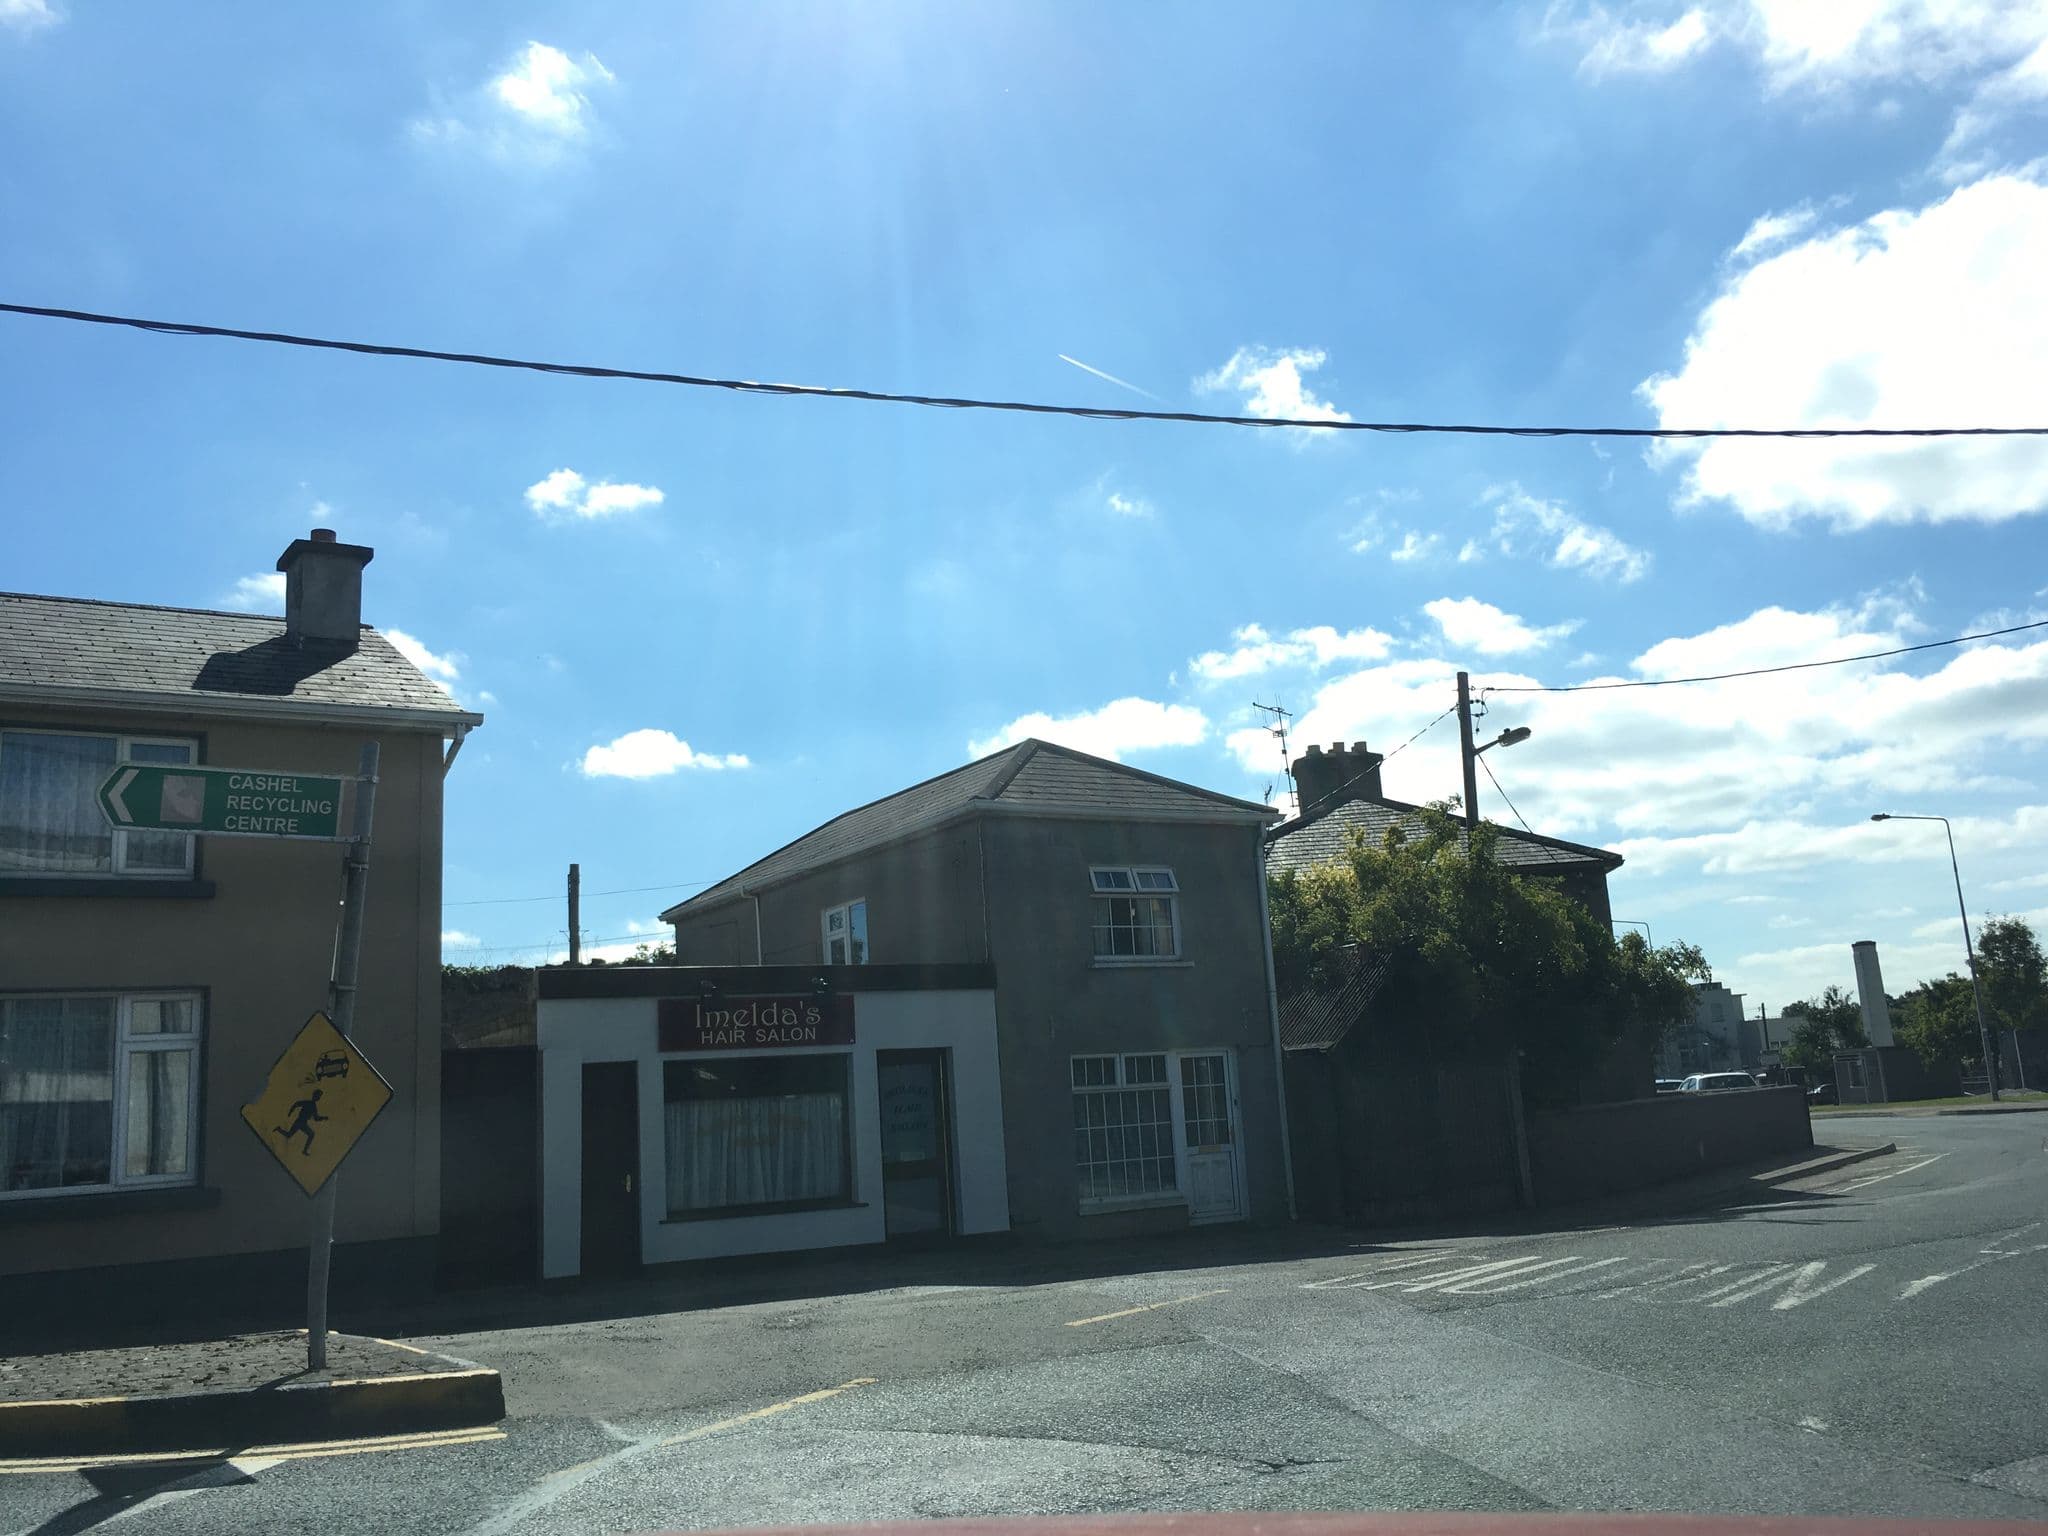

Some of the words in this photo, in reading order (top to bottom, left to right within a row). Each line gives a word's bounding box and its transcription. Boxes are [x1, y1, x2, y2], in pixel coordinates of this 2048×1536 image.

[228, 775, 303, 793] CASHEL
[226, 795, 332, 815] RECYCLING
[224, 815, 299, 833] CENTRE
[696, 1001, 821, 1029] Imelda's
[701, 1029, 746, 1044] HAIR
[755, 1027, 817, 1042] SALON
